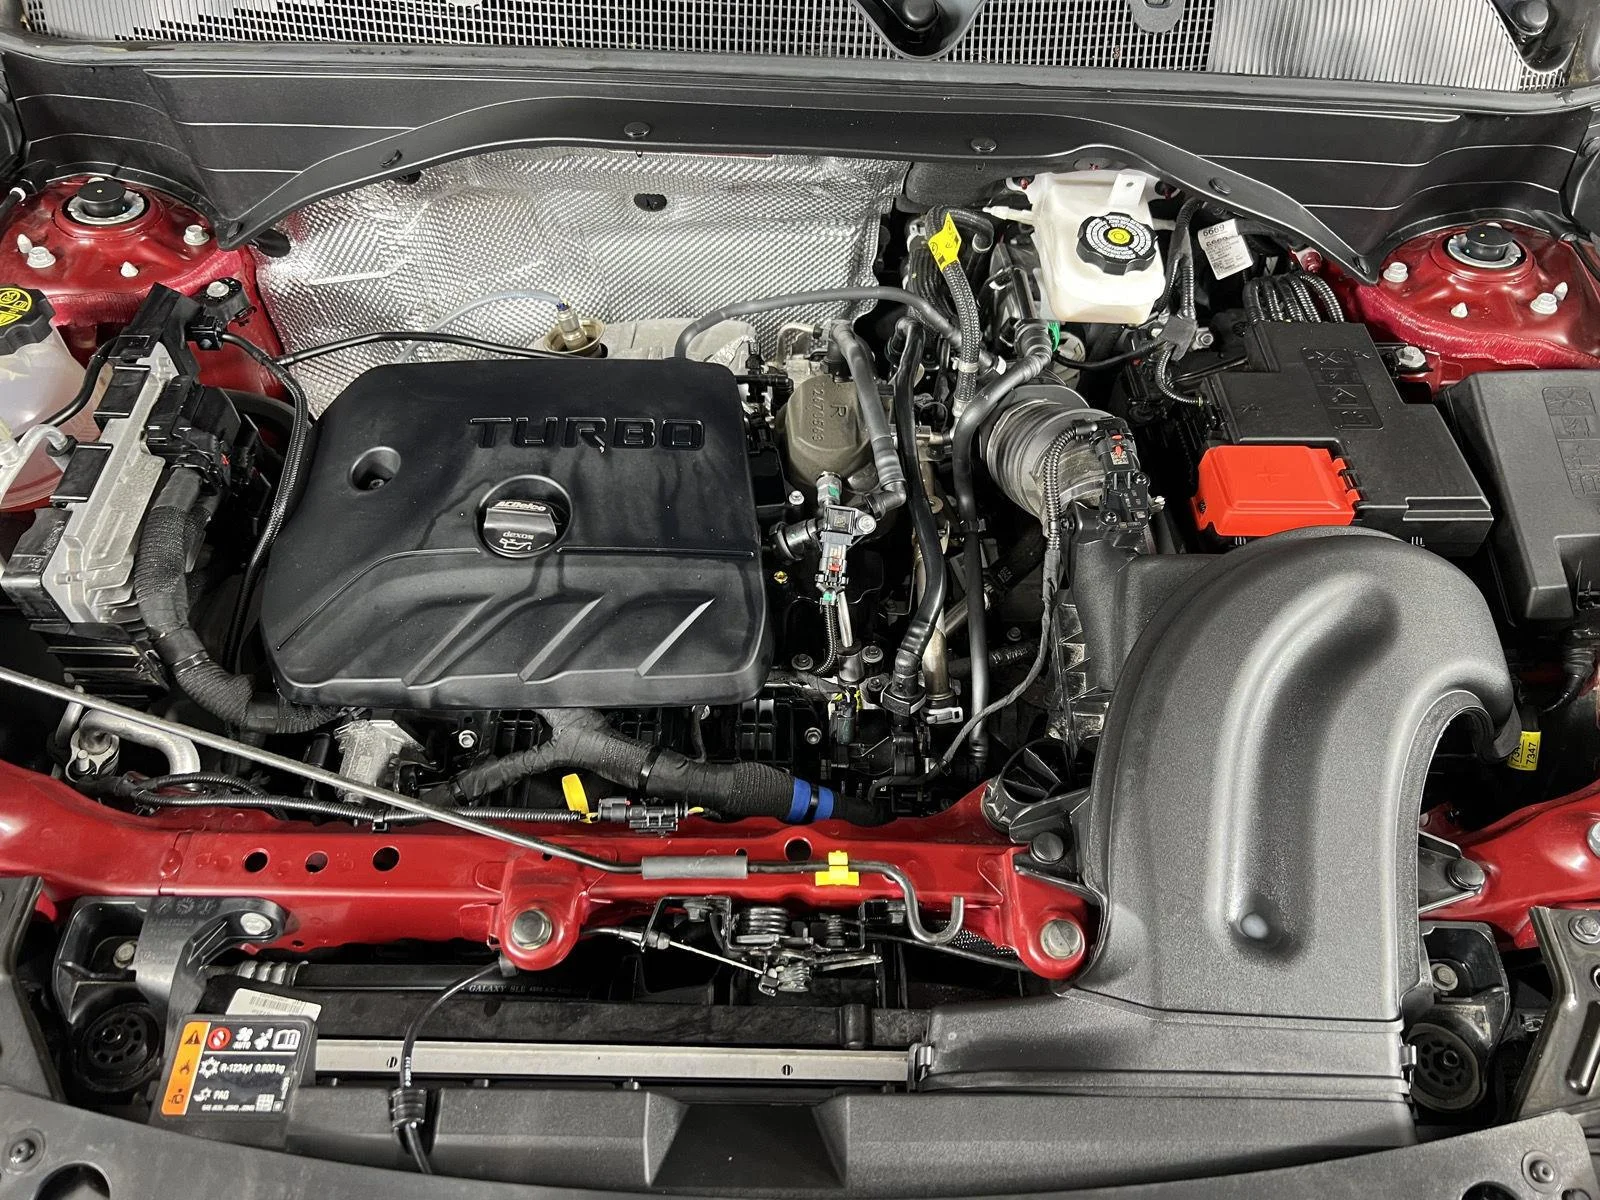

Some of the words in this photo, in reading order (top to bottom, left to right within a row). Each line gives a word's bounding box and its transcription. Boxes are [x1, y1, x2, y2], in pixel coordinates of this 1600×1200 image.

[830, 404, 848, 418] R
[469, 417, 706, 450] TURBO
[494, 501, 547, 512] ACDelco
[502, 531, 535, 540] dexos
[1526, 742, 1536, 765] 7347
[468, 984, 507, 993] GALAXY
[232, 1041, 251, 1050] AUTO
[275, 1063, 286, 1075] kg
